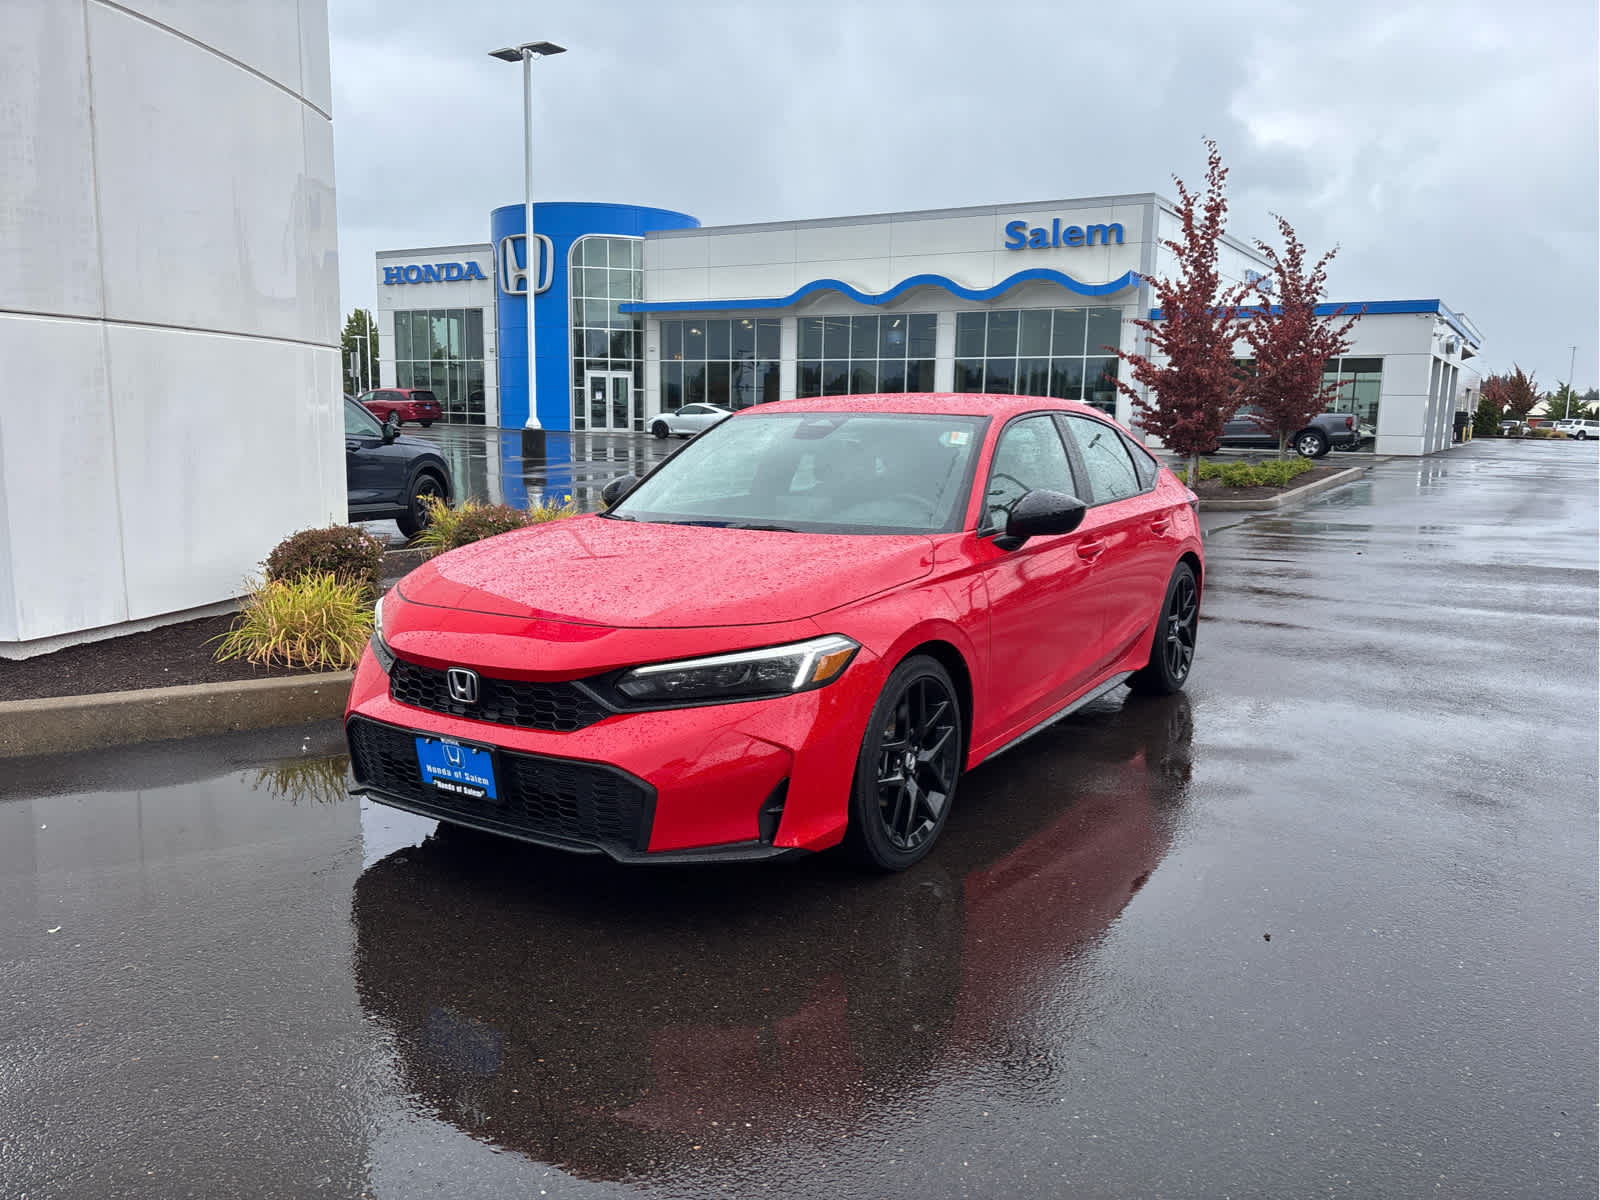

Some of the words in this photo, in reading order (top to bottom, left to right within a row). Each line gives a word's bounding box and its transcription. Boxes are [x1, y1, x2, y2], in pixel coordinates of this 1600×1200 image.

[1005, 218, 1124, 250] Salem
[383, 261, 487, 285] HONDA
[426, 764, 452, 776] Honda
[454, 771, 462, 779] of
[464, 772, 489, 786] Salem
